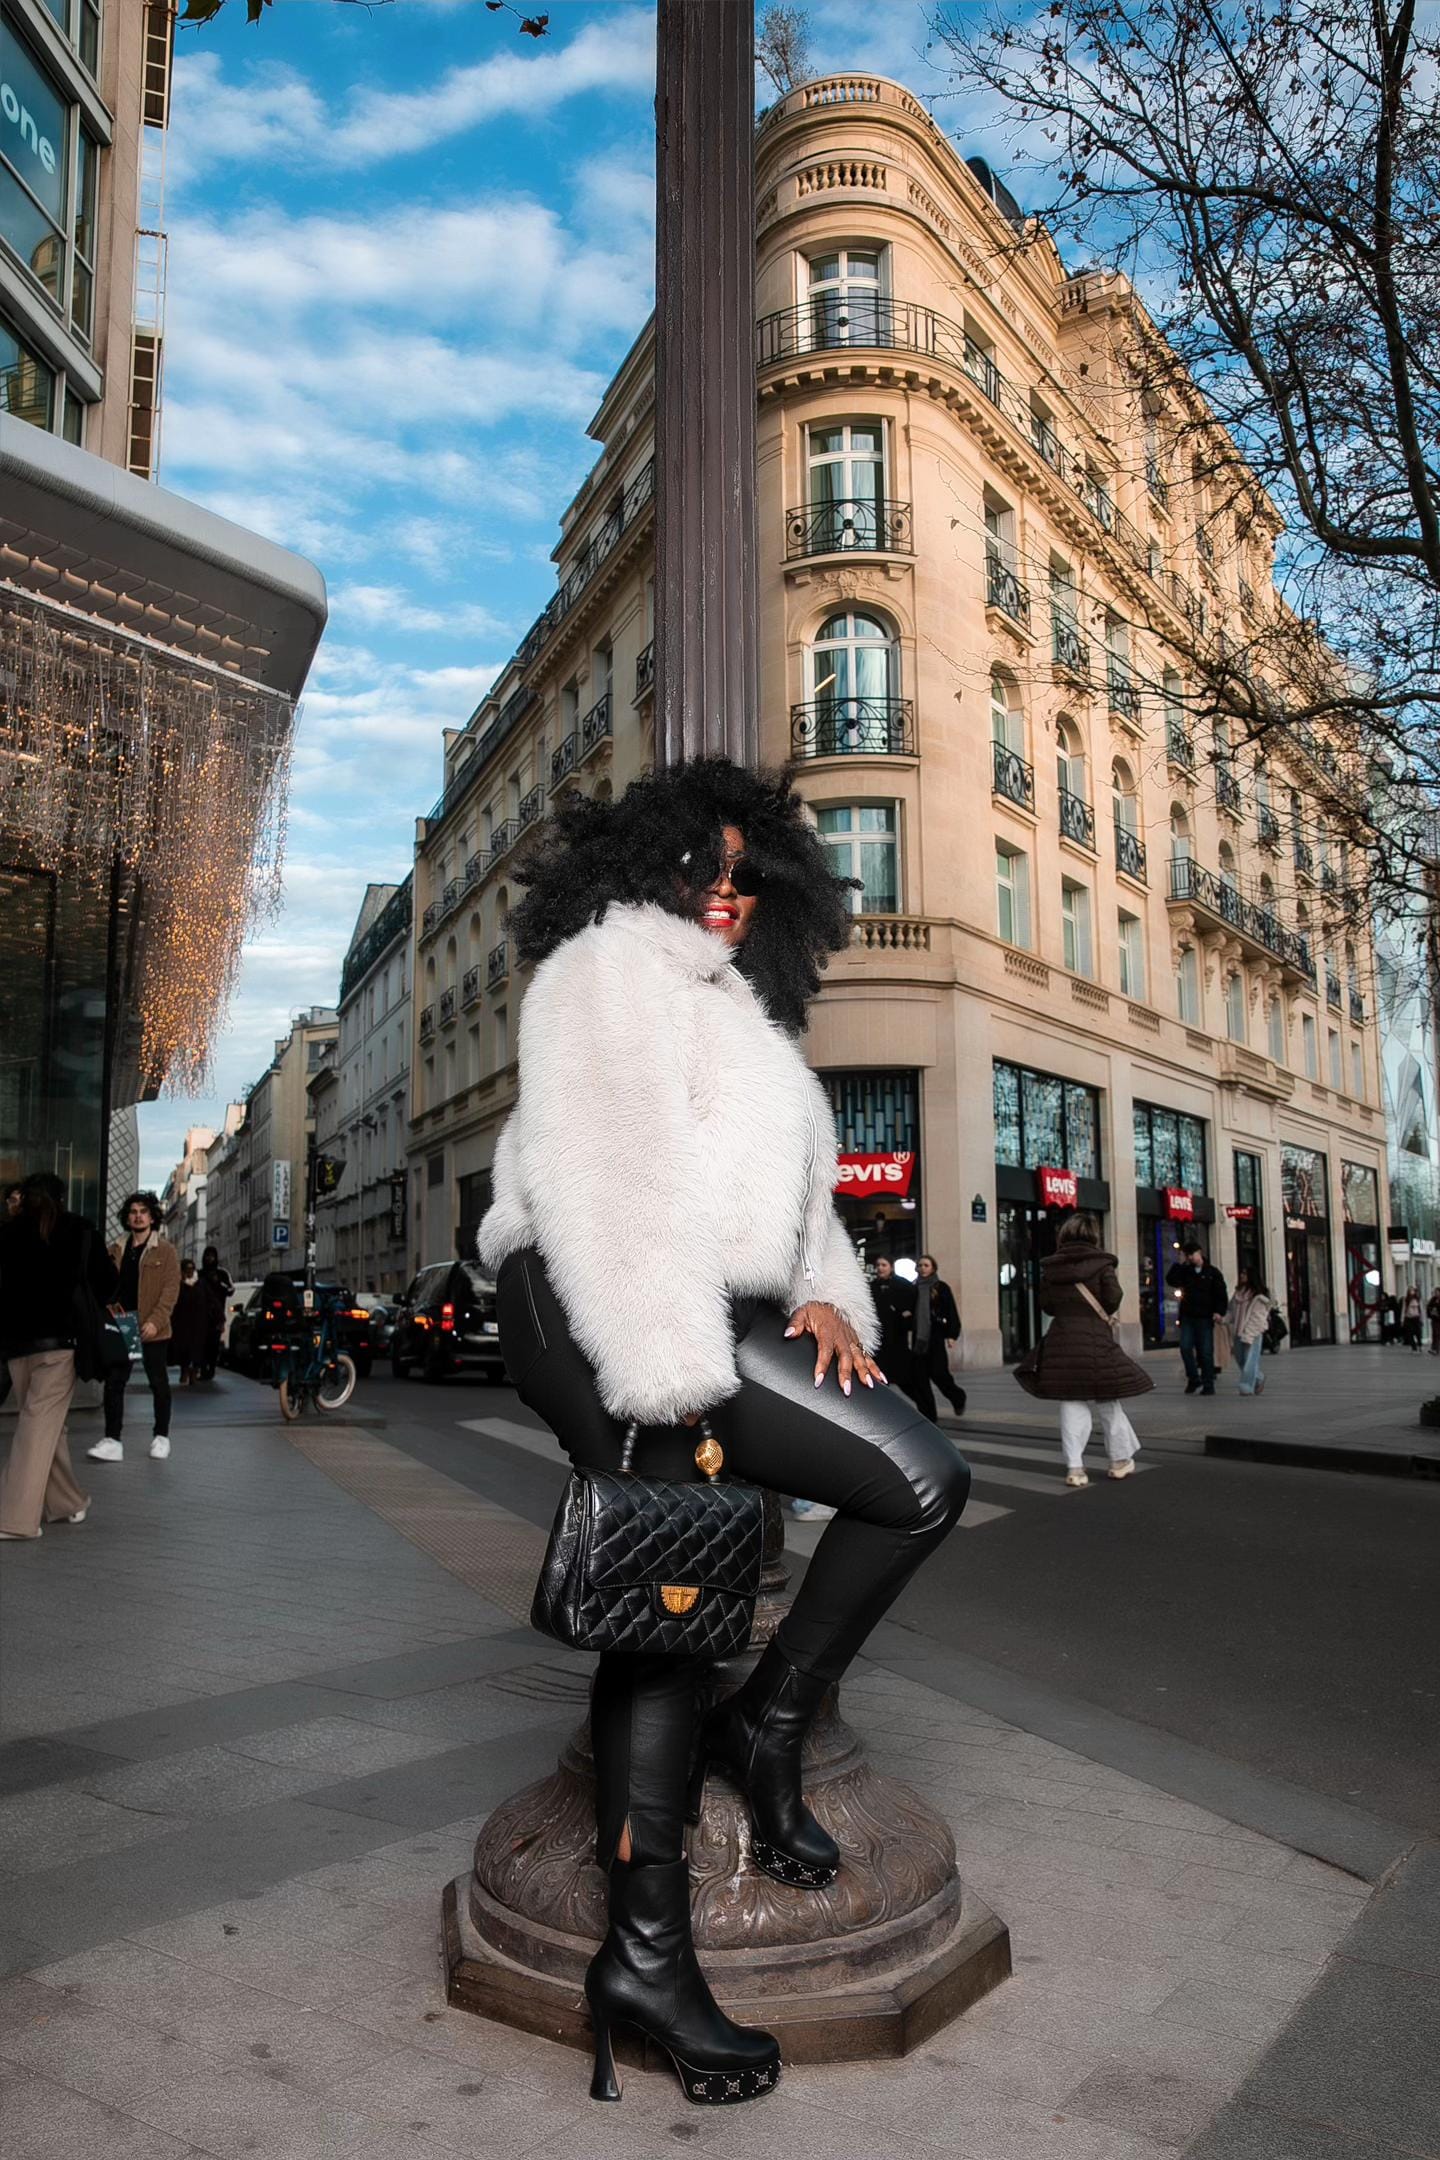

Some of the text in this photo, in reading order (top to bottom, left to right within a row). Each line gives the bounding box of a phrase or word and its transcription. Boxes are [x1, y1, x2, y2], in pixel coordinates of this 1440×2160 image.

[1, 83, 56, 174] one
[837, 1163, 904, 1182] evi's
[276, 1227, 287, 1241] P
